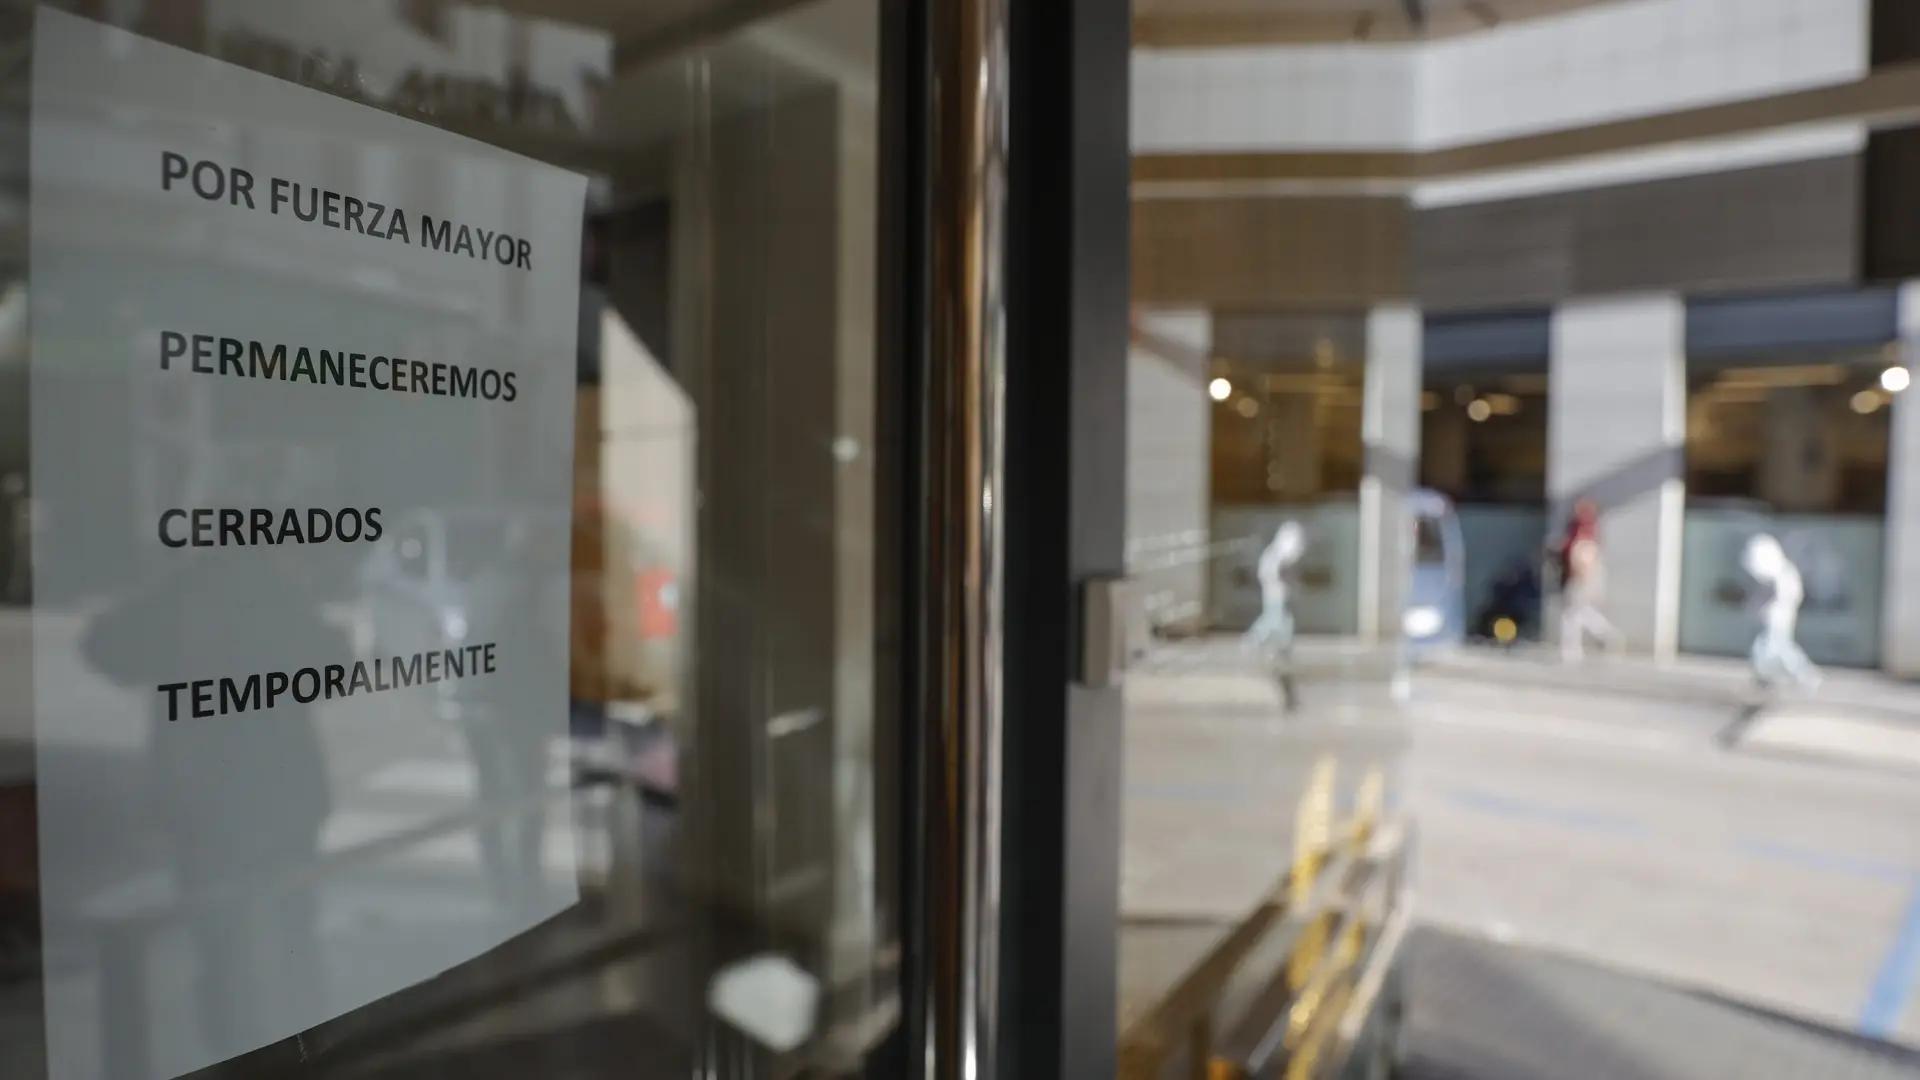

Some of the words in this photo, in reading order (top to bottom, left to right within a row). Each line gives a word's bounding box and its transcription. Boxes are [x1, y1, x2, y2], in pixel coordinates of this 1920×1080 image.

[161, 151, 256, 210] POR
[270, 177, 411, 244] FUERZA
[421, 214, 533, 272] MAYOR
[160, 330, 518, 402] PERMANECEREMOS
[158, 507, 383, 548] CERRADOS
[157, 642, 497, 722] TEMPORALMENTE
